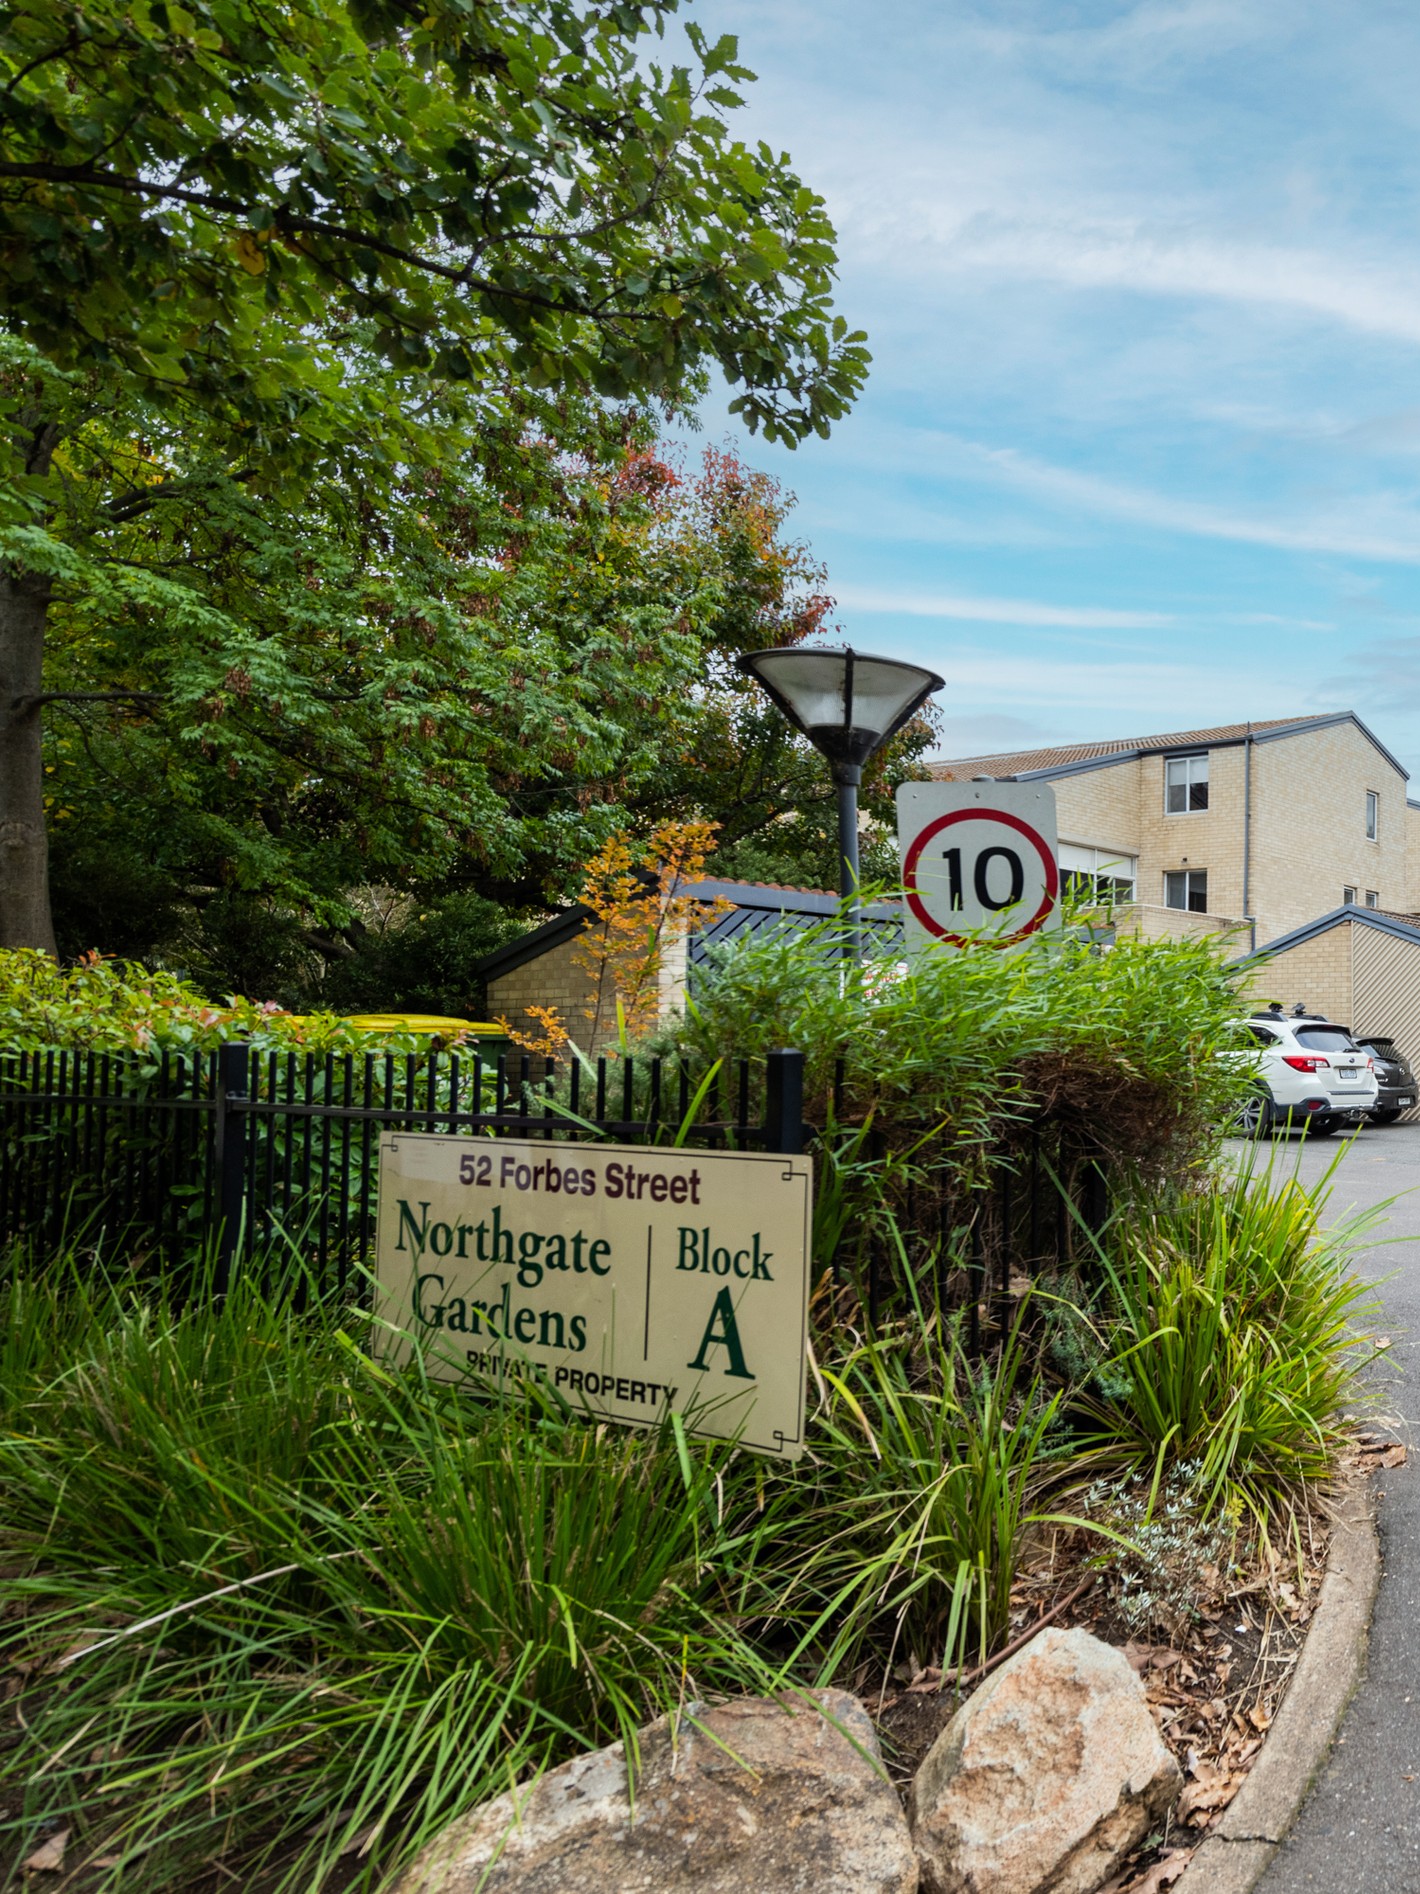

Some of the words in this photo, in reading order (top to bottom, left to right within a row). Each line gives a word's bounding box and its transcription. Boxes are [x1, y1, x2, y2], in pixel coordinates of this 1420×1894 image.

[942, 846, 1024, 912] 10
[459, 1154, 492, 1187] 52
[500, 1156, 596, 1196] Forbes
[605, 1162, 701, 1205] Street
[395, 1199, 612, 1288] Northgate
[676, 1226, 774, 1281] Block
[412, 1273, 587, 1352] Gardens
[687, 1285, 756, 1381] A
[555, 1366, 679, 1409] PROPERTY
